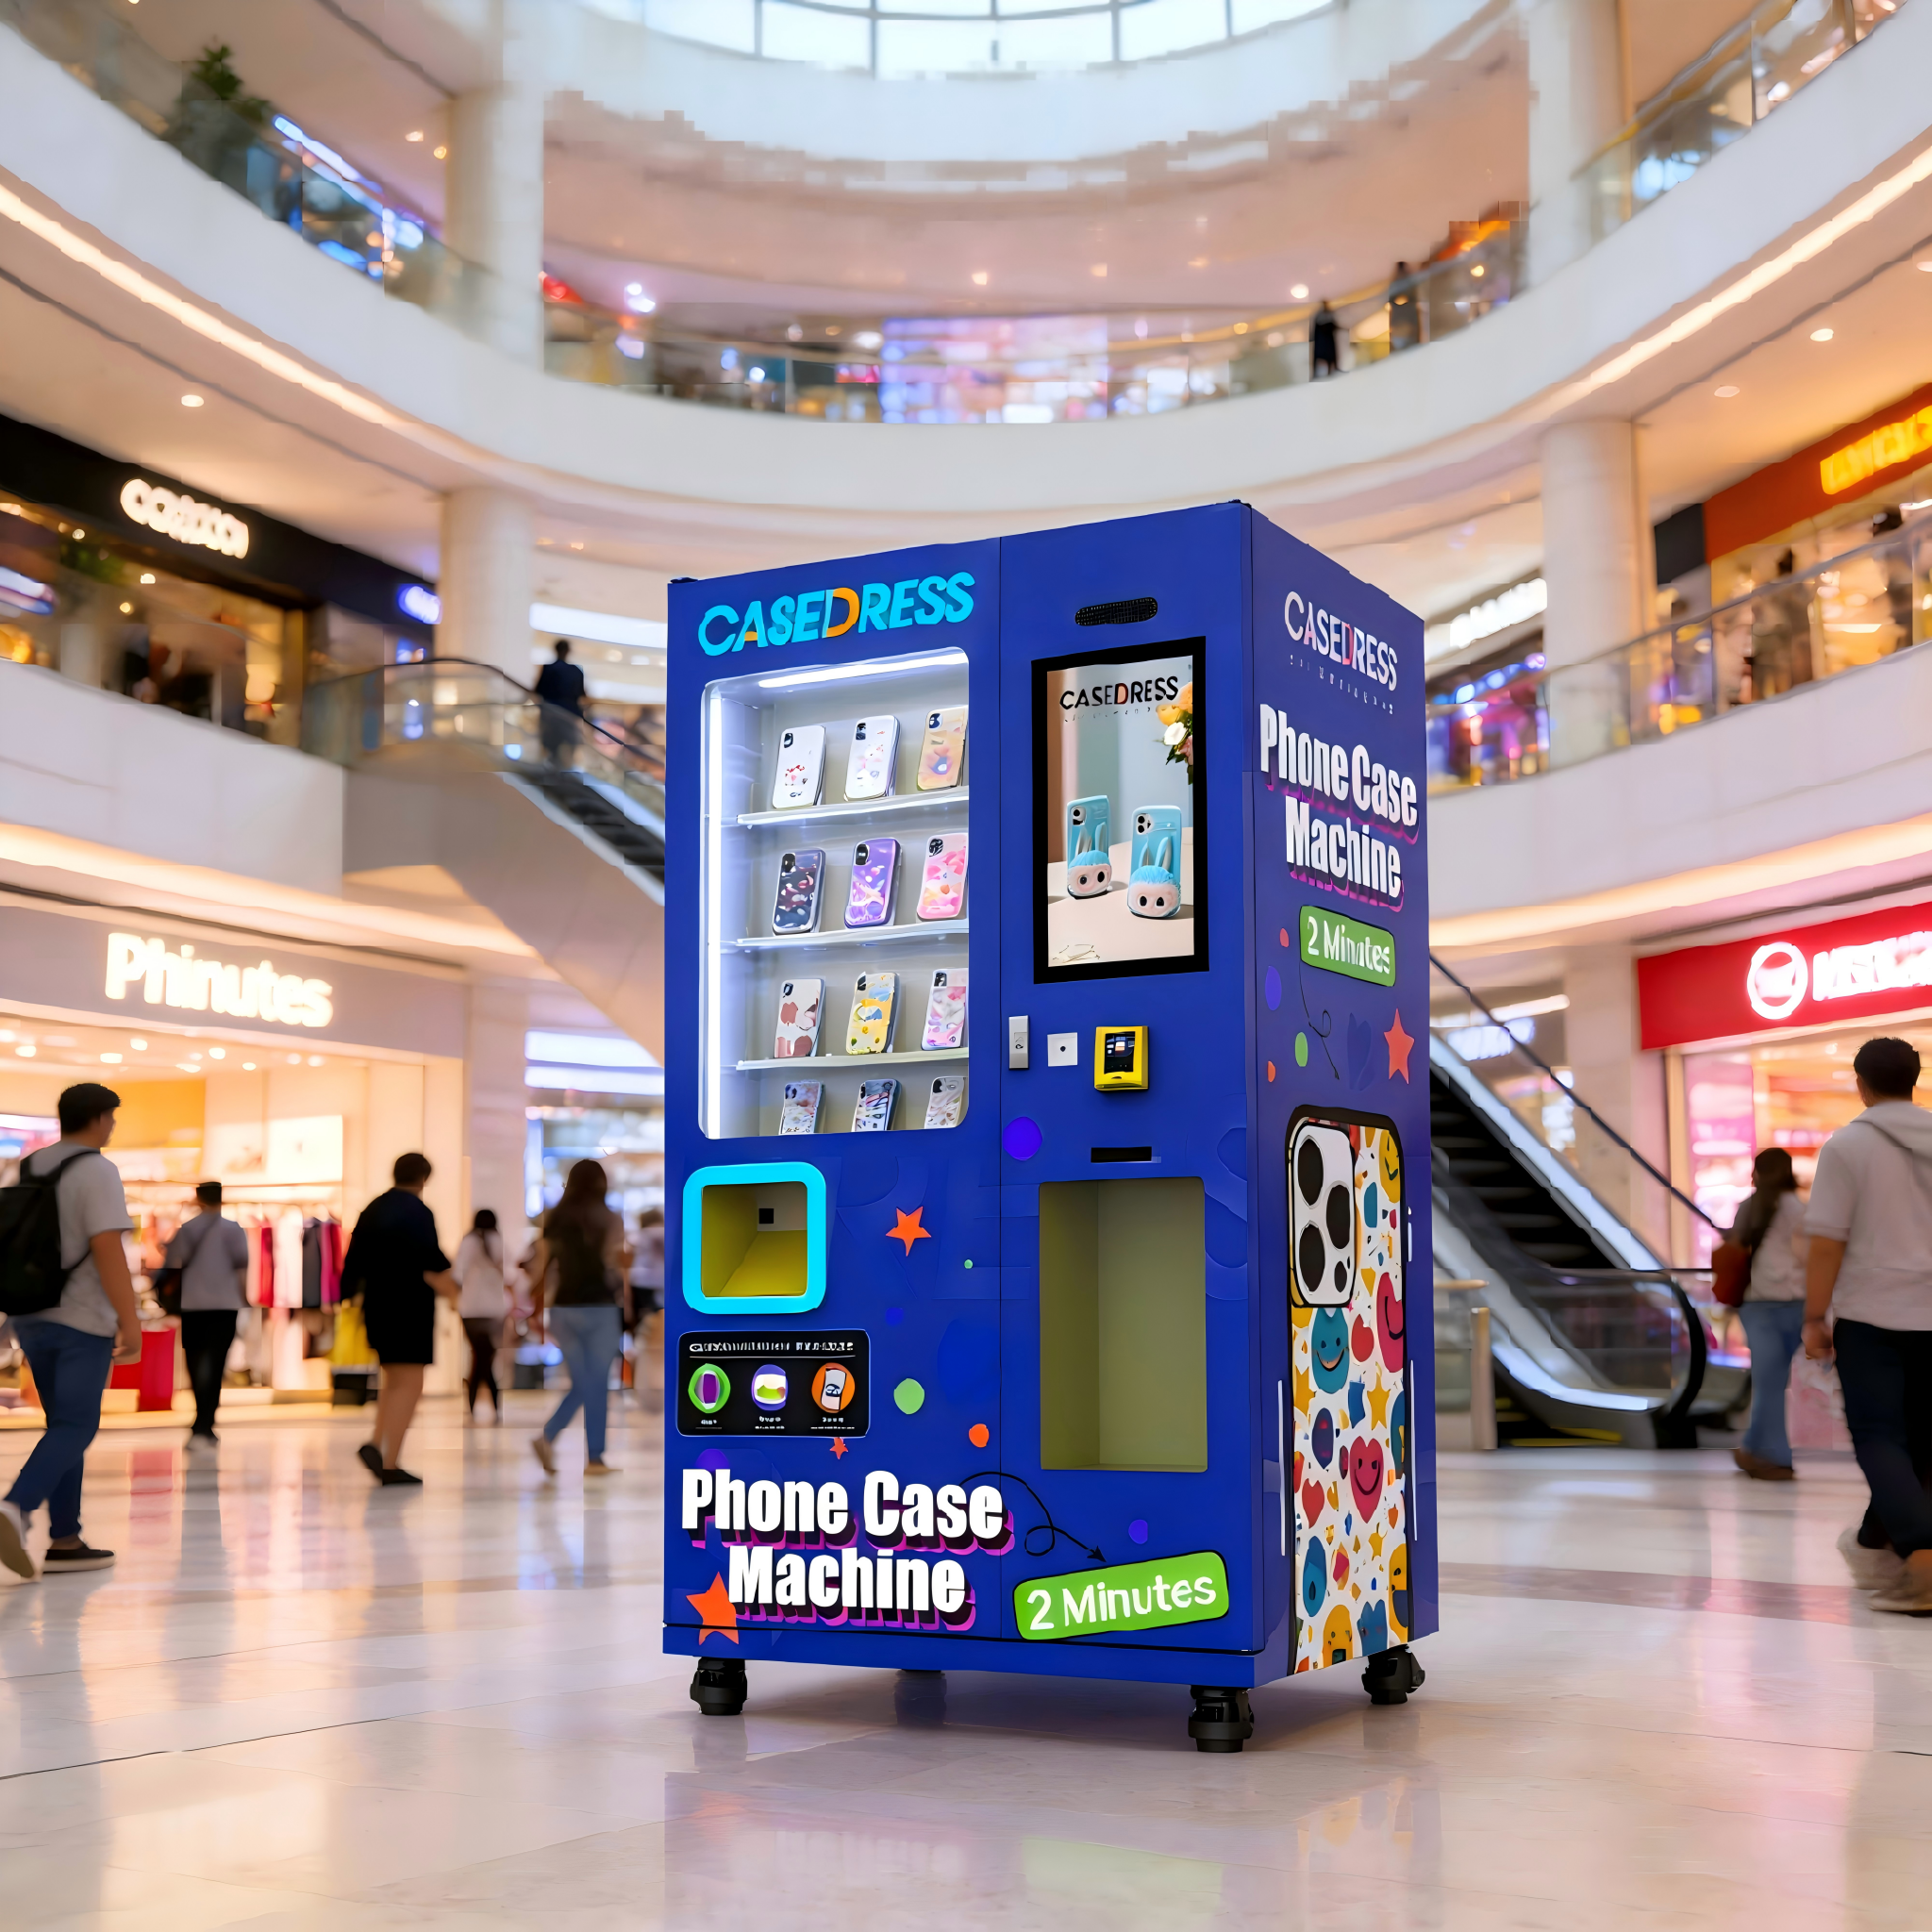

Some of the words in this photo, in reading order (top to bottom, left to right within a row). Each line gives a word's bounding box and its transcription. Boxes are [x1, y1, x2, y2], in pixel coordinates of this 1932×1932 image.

[698, 571, 975, 657] CASEDRESS
[1284, 591, 1398, 691] CASEDRESS
[1059, 675, 1179, 710] CASEDRESS
[1259, 703, 1349, 802] Phone
[1352, 743, 1418, 827] Case
[1285, 795, 1402, 899] Machine
[1307, 915, 1320, 957] 2
[681, 1468, 849, 1535] Phone
[863, 1470, 1004, 1540] Case
[727, 1544, 966, 1613] Machine
[1025, 1588, 1056, 1632] 2
[1063, 1572, 1217, 1625] Minutes
